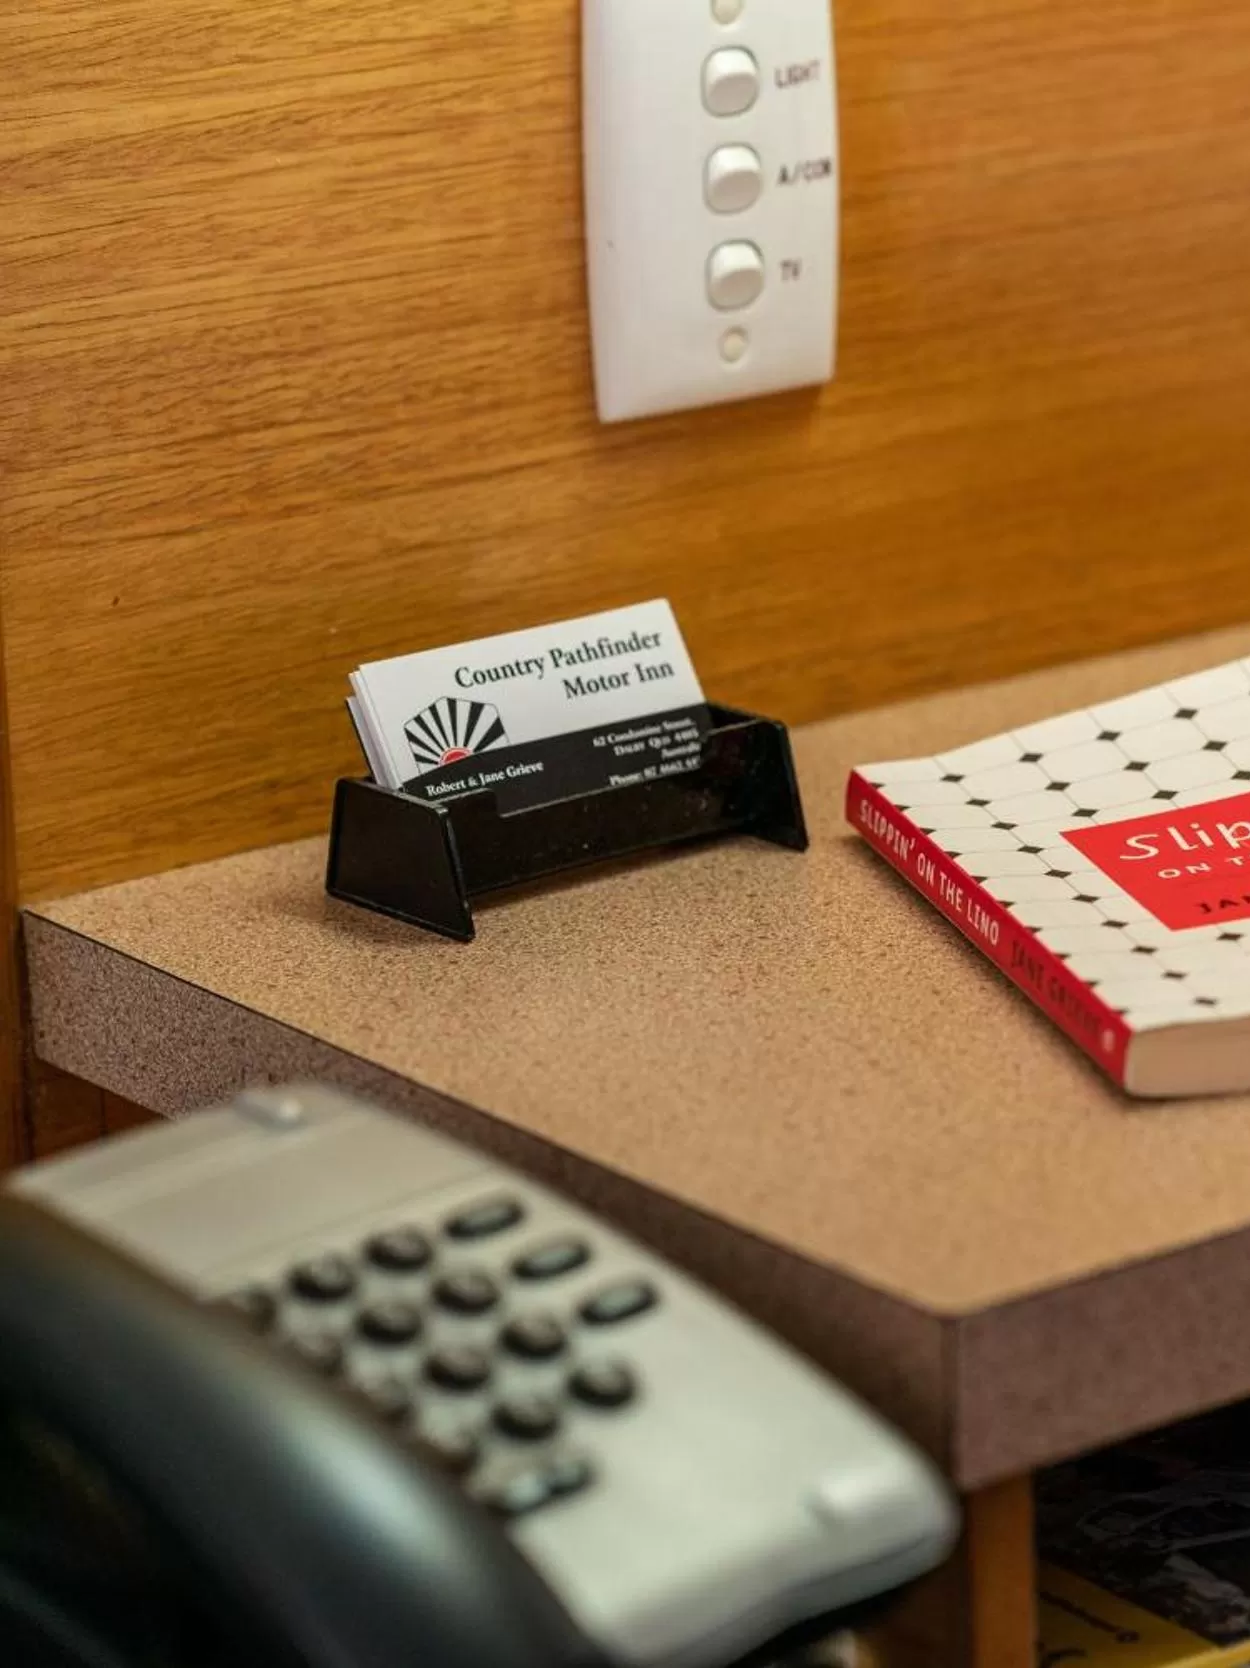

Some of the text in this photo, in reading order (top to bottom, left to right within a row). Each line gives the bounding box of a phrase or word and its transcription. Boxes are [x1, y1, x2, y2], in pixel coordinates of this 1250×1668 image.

[774, 59, 821, 90] LIGHT
[780, 258, 801, 282] TV
[454, 630, 662, 689] Country Pathfinder
[563, 660, 675, 700] Motor Inn
[425, 761, 545, 797] Robert & Jane Grieve
[858, 799, 917, 862] SLIPPIN'
[916, 852, 935, 888] ON
[939, 870, 964, 914] THE
[966, 897, 1001, 948] LINO
[1156, 862, 1212, 881] ON
